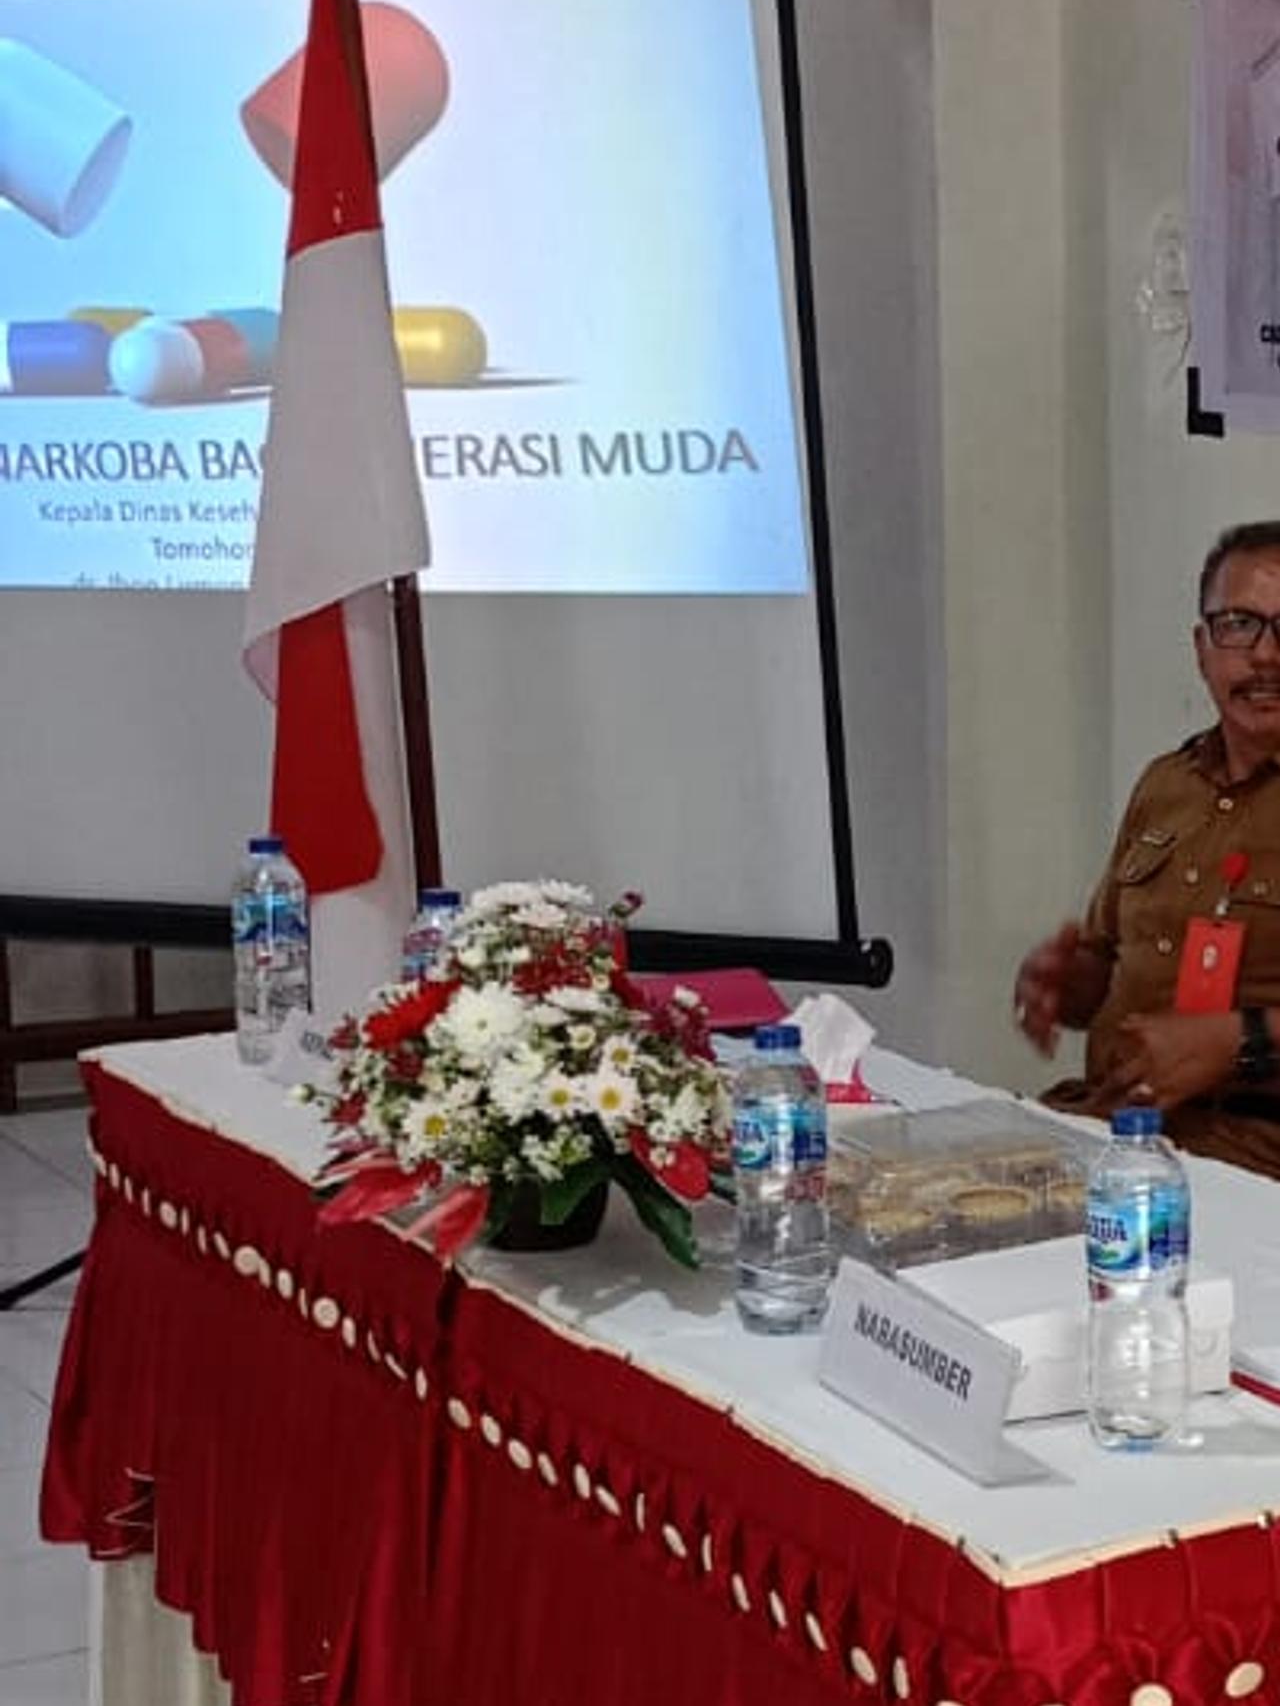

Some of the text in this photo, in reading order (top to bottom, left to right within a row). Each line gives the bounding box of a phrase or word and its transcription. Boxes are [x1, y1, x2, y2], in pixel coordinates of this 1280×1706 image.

[199, 439, 266, 481] BA
[420, 432, 562, 480] ERASI
[578, 428, 761, 478] MUDA
[39, 497, 113, 527] Kepala
[119, 500, 183, 522] Dinas
